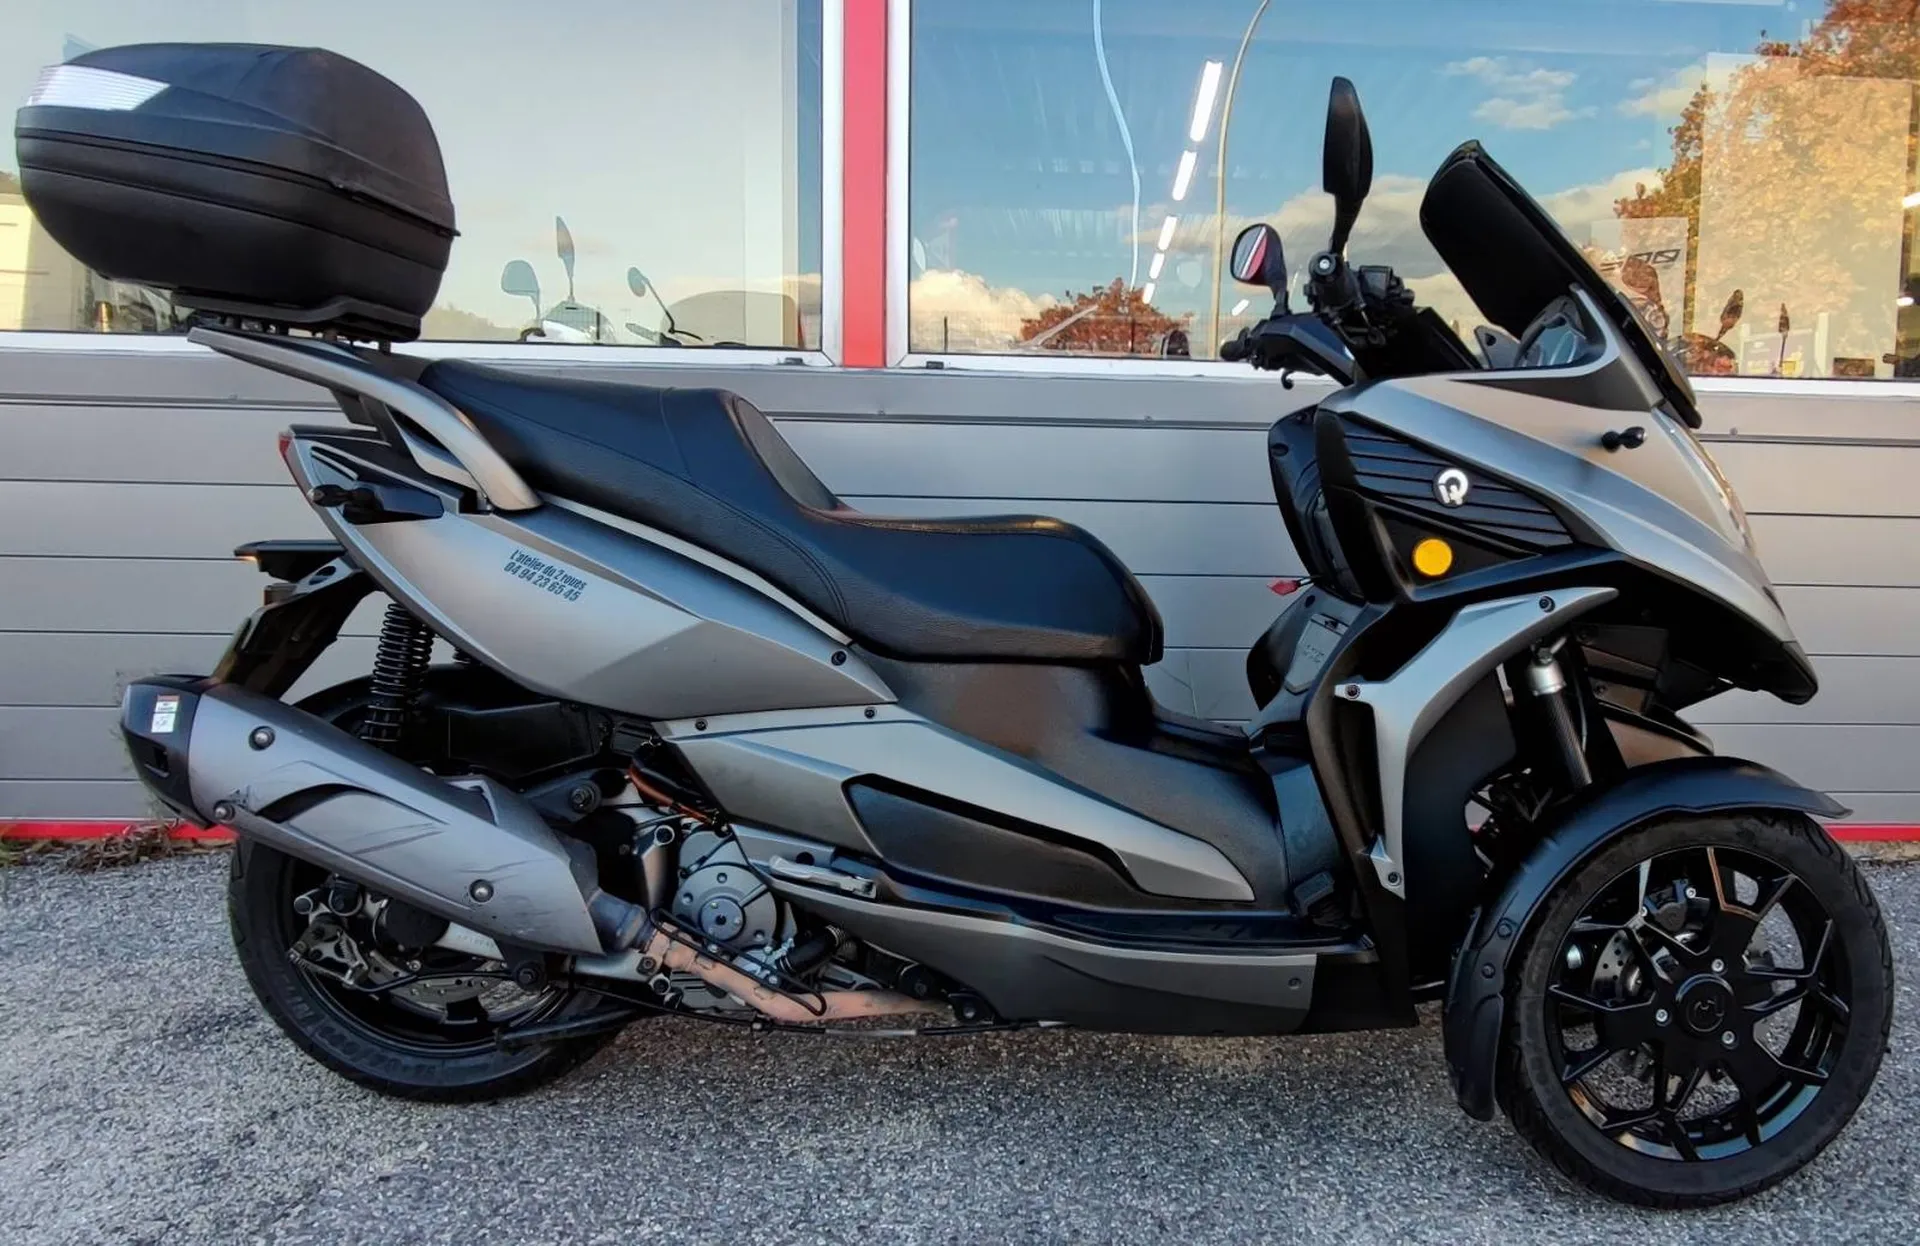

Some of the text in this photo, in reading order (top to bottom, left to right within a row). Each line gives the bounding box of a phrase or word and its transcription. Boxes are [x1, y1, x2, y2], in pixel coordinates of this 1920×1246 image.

[503, 561, 521, 575] 04
[518, 568, 535, 581] 94
[532, 575, 551, 588] 23
[563, 588, 581, 602] 45
[510, 549, 545, 571] L'atelier
[554, 569, 565, 580] 2
[560, 573, 587, 590] roues
